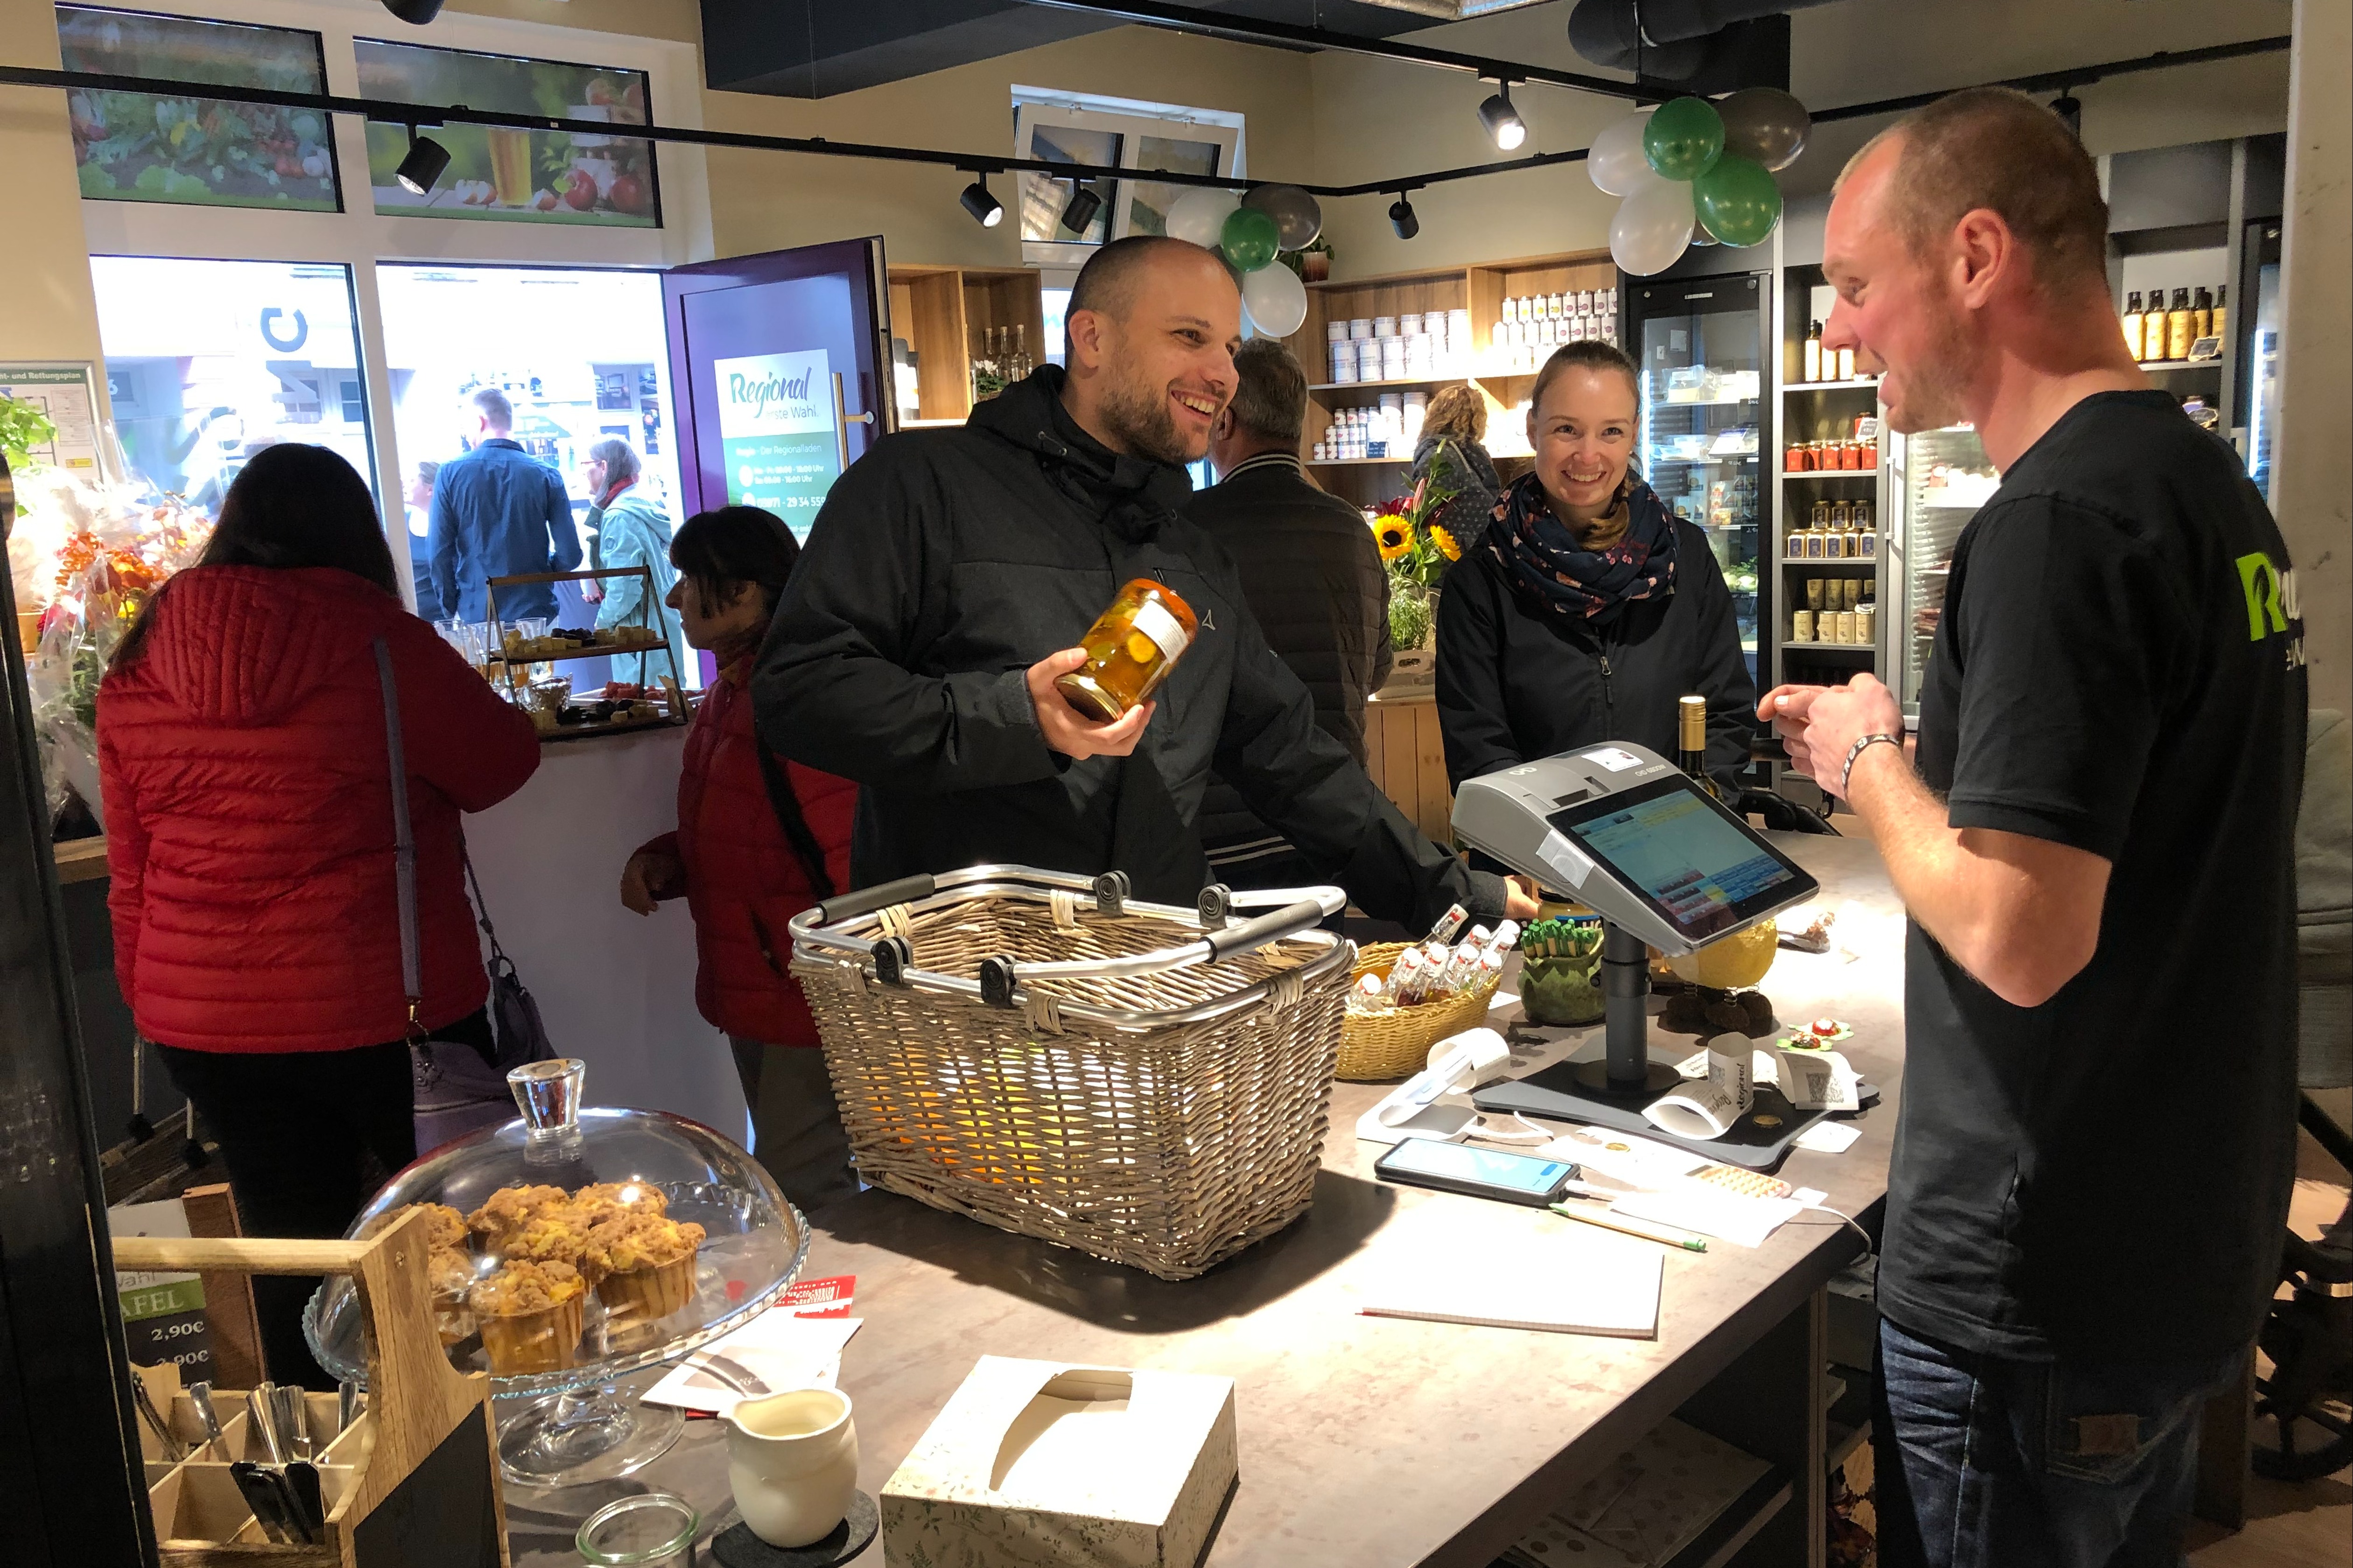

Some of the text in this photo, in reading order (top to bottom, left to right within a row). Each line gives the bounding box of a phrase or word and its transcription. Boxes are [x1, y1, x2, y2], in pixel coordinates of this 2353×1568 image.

[28, 372, 81, 380] Rettungsplan
[730, 366, 812, 418] Regional
[151, 1321, 205, 1341] 2,90€
